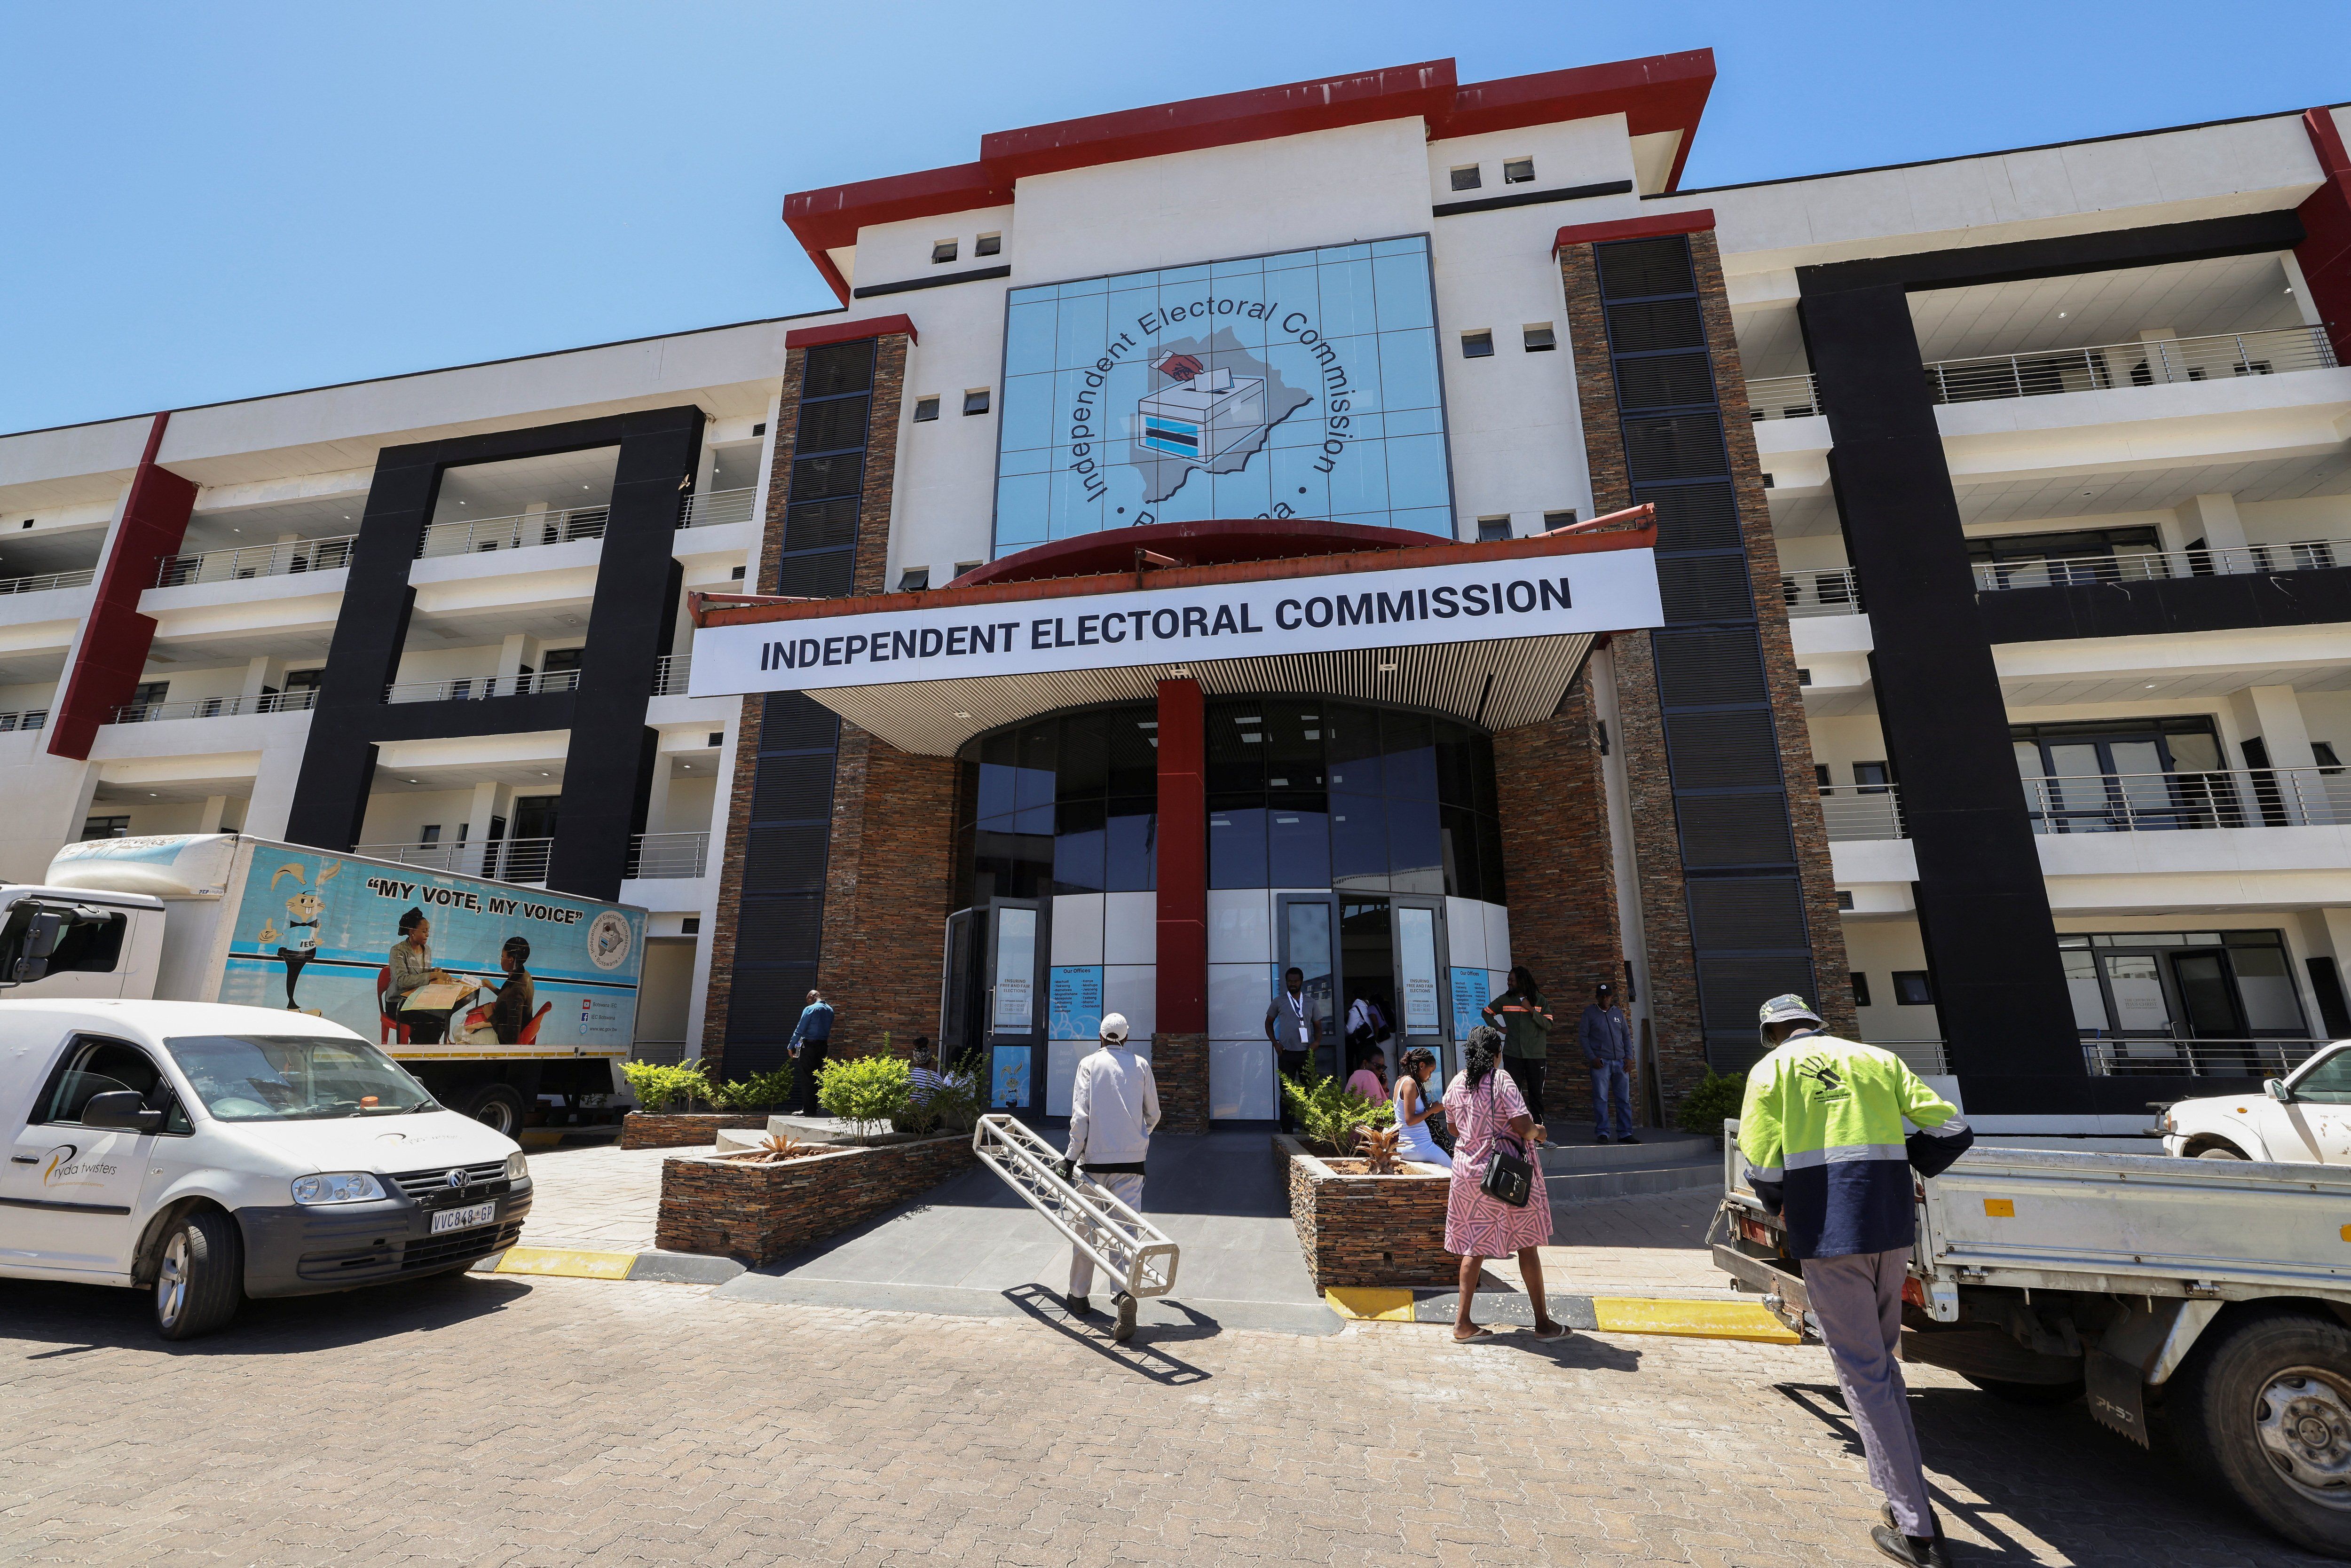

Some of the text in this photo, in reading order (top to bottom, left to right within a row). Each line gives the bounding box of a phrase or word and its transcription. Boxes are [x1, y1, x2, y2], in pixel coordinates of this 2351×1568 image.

[1070, 296, 1355, 503] Independent Electoral Commission
[760, 577, 1572, 670] INDEPENDENT ELECTORAL COMMISSION
[367, 878, 584, 924] “MY VOTE, MY VOICE”
[590, 918, 602, 954] Independent
[603, 914, 622, 922] Electoral
[596, 957, 618, 967] Botswana
[81, 1162, 117, 1175] twisters
[481, 1206, 492, 1221] GP
[2096, 1395, 2136, 1426] アトラス
